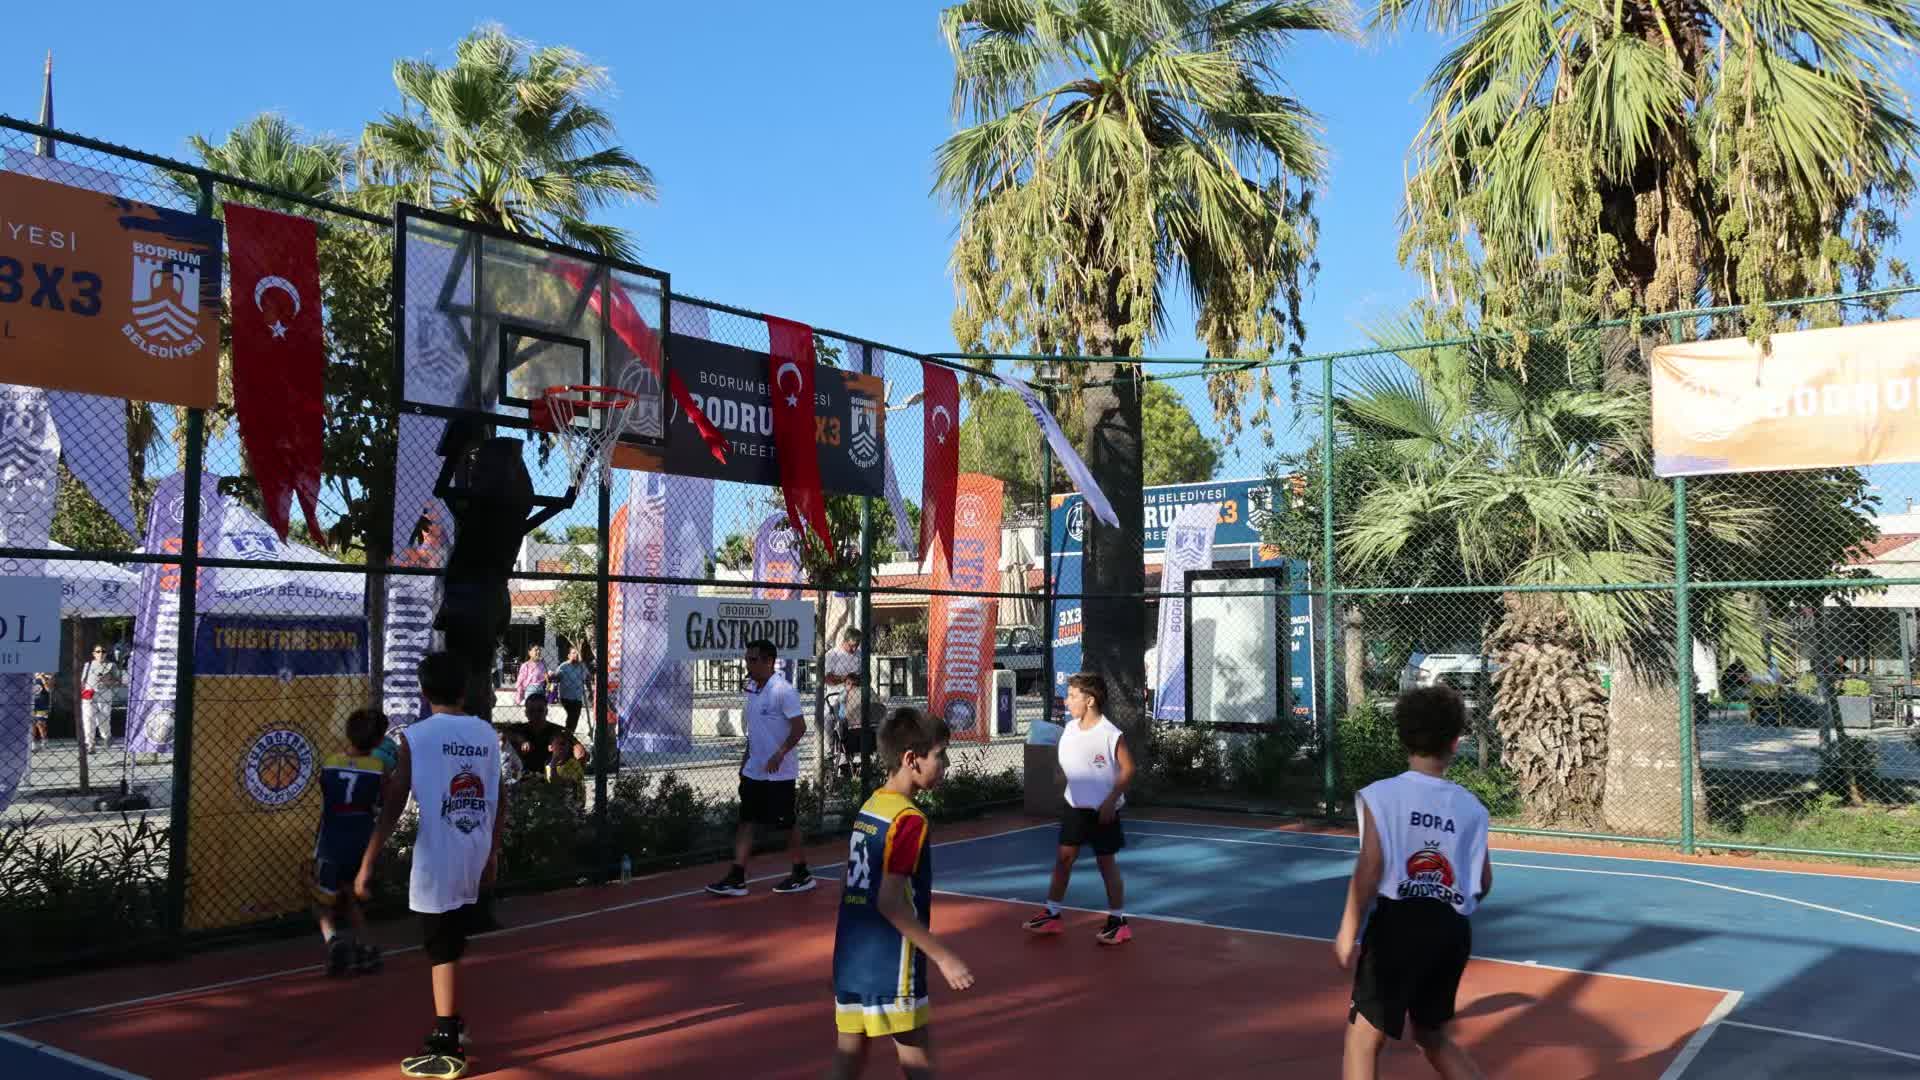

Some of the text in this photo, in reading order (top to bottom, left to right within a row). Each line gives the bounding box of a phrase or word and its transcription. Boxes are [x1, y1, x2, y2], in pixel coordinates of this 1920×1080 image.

[133, 241, 201, 266] BODRUM
[121, 323, 206, 359] BELEDİYESİ
[700, 371, 754, 393] BODRUM
[688, 393, 774, 436] BODRU
[1159, 488, 1226, 504] BELEDİYESİ
[725, 606, 764, 616] BODRUM
[1060, 608, 1082, 626] 3X3
[686, 611, 800, 650] GASTROPUB
[442, 742, 488, 757] RÜZGAR
[338, 771, 359, 805] 7
[1410, 811, 1456, 833] BORA
